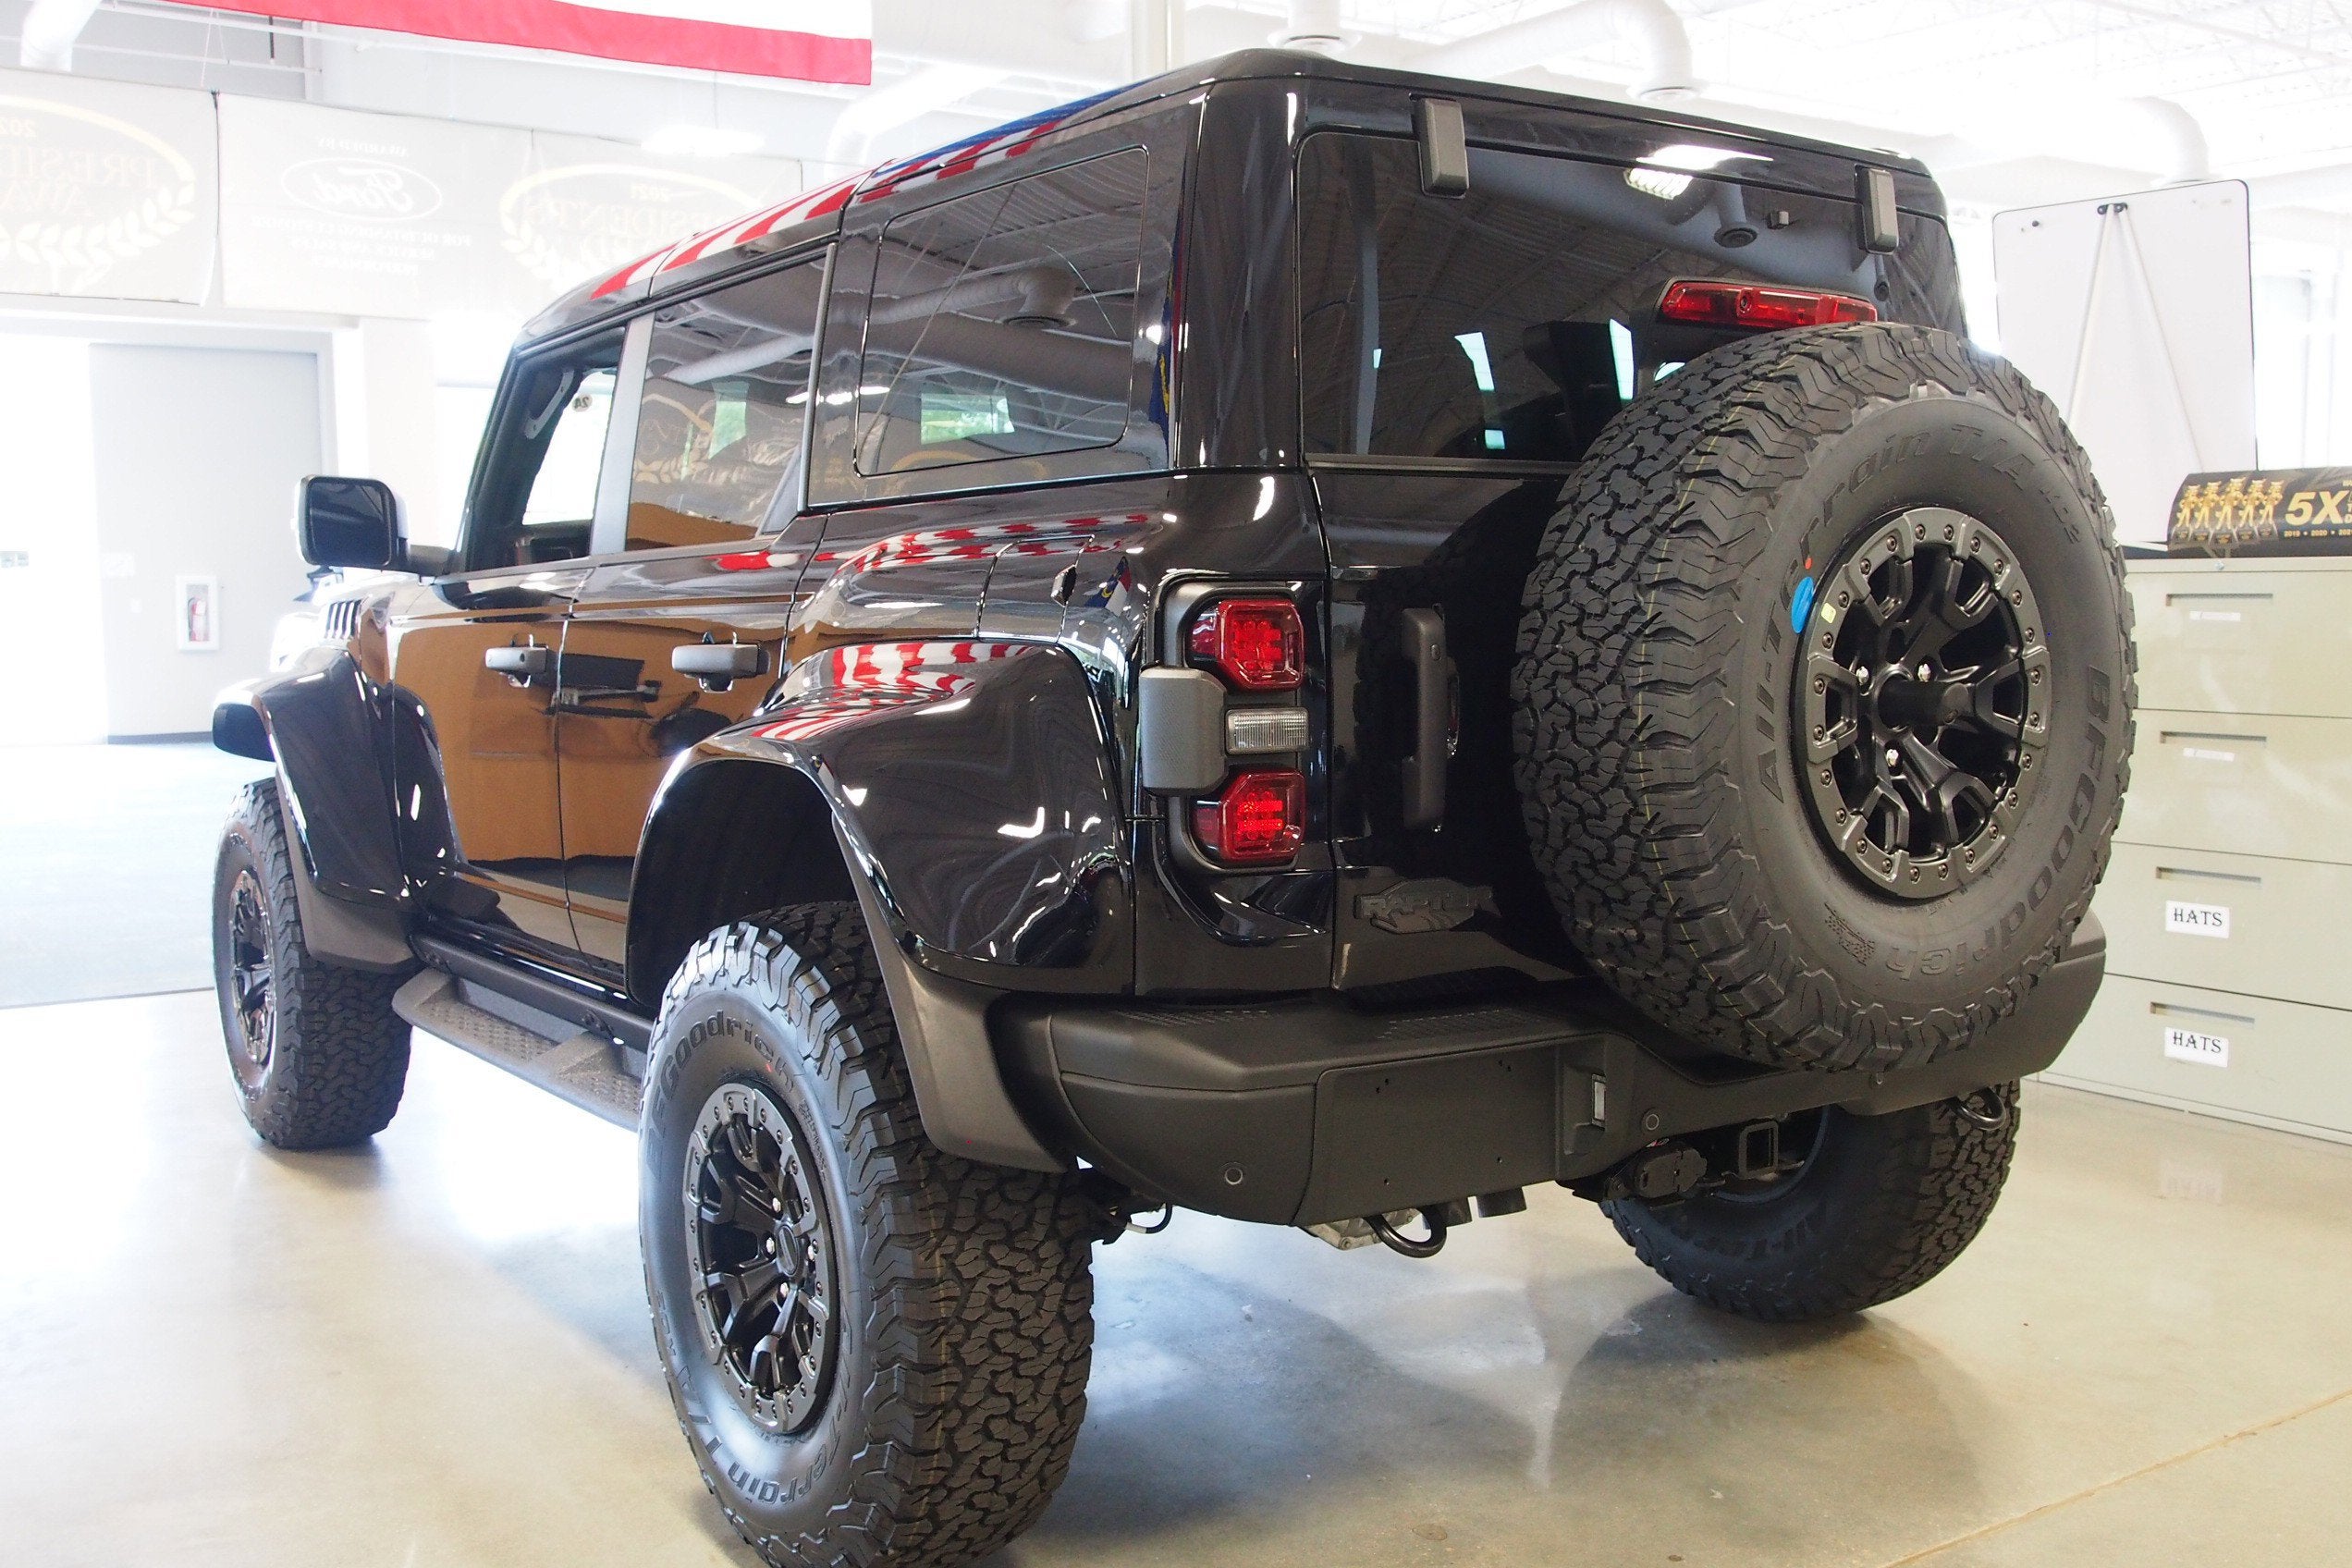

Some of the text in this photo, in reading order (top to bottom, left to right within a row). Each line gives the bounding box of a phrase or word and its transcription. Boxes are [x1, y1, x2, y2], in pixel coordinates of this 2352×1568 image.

[2285, 489, 2350, 526] 5X
[1885, 664, 2111, 981] BFGoodrich
[1354, 885, 1502, 925] RAPTOR
[2173, 907, 2223, 928] HATS
[2172, 1030, 2222, 1054] HATS
